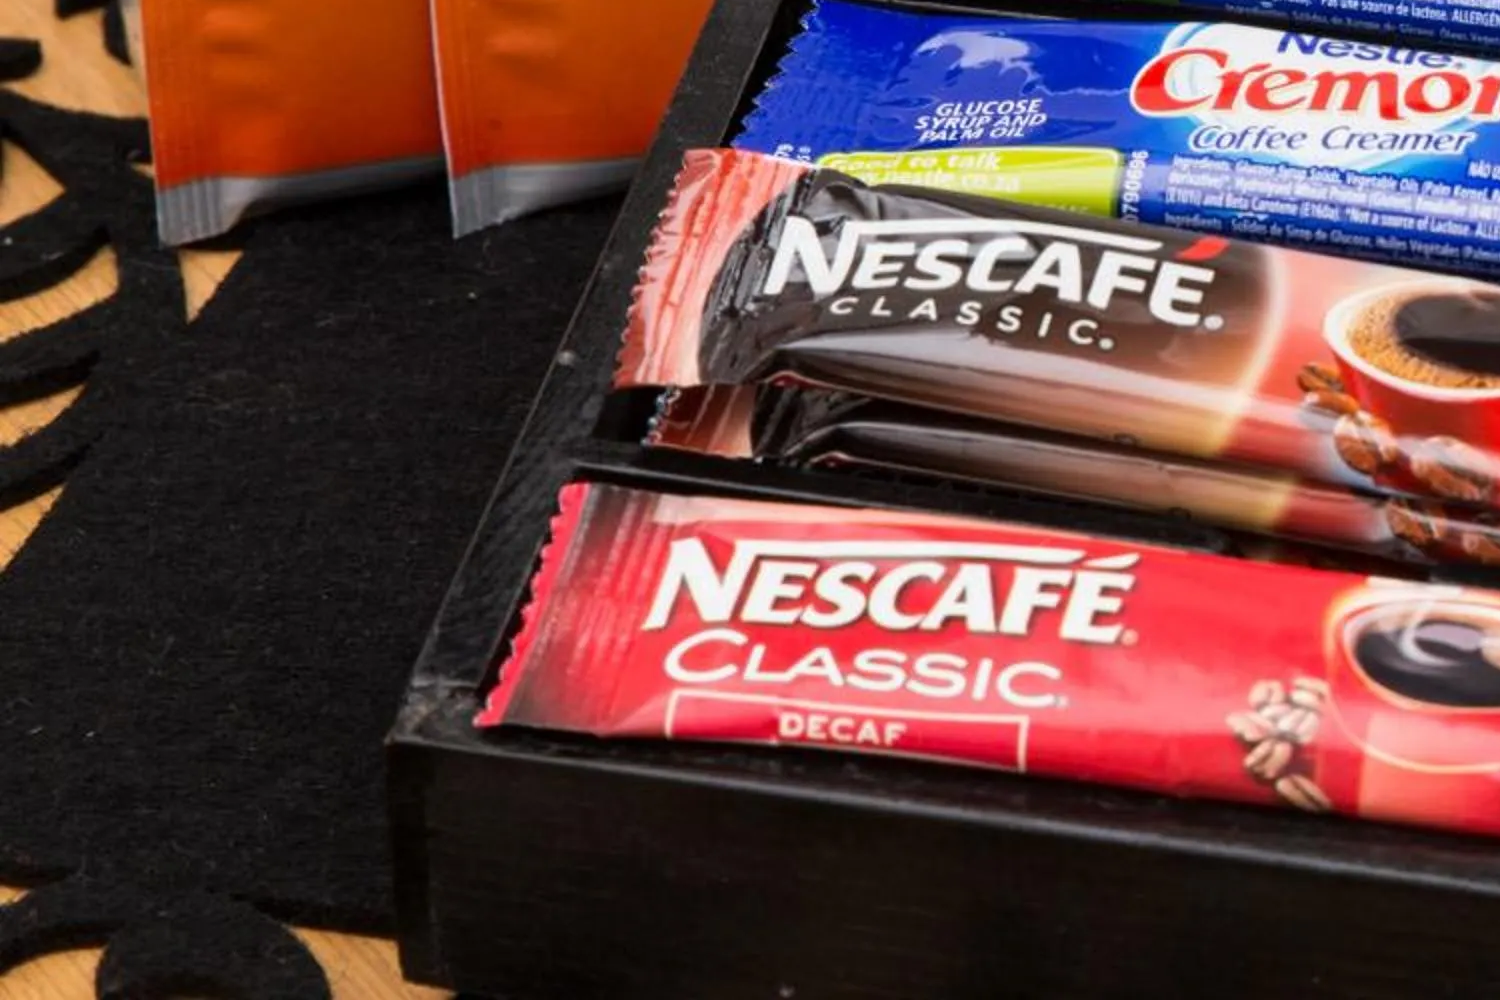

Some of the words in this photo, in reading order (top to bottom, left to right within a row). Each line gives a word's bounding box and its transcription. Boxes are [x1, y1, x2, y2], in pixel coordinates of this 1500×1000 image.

[914, 115, 991, 130] SYRUP
[994, 112, 1048, 128] AND
[935, 98, 1043, 117] GLUCOSE
[918, 128, 983, 143] PALM
[989, 127, 1025, 138] OIL
[1190, 124, 1309, 152] Coffee
[1319, 124, 1478, 155] Creamer
[641, 536, 1141, 645] NESCAFÉ
[663, 628, 1062, 708] CLASSIC
[778, 711, 908, 747] DECAF
